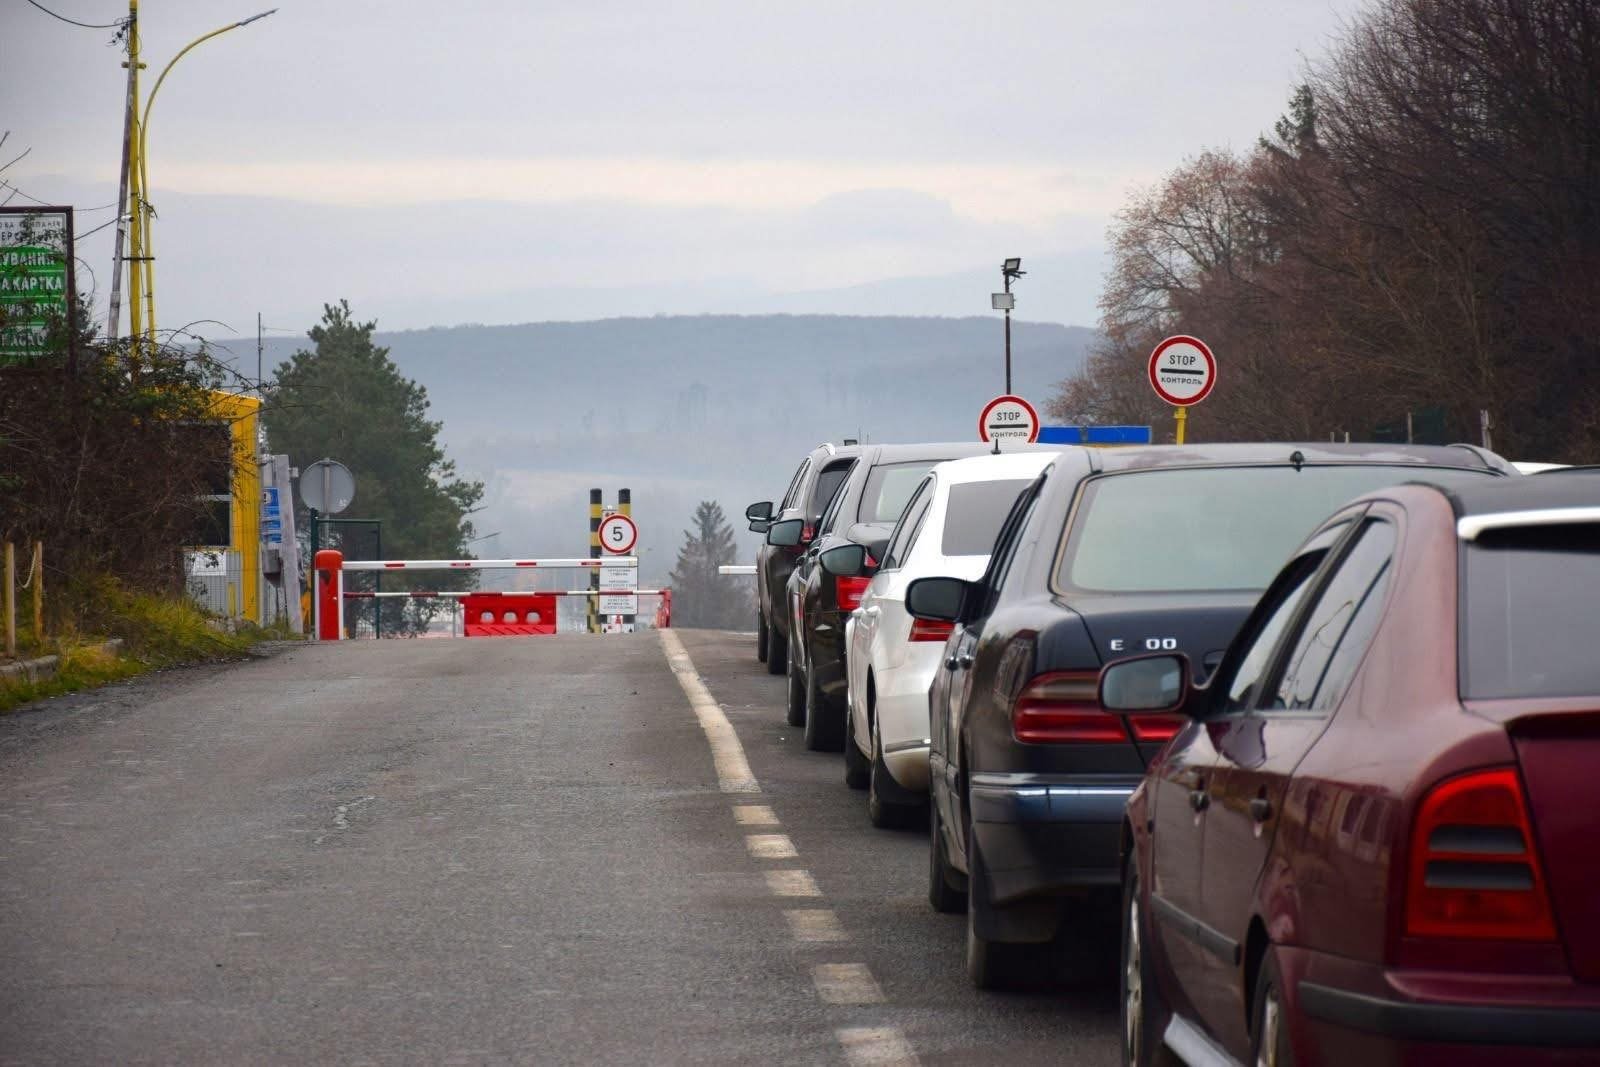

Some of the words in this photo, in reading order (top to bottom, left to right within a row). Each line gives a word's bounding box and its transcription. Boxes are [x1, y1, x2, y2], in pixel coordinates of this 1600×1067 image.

[12, 276, 62, 290] КАРТКА
[1169, 354, 1196, 366] STOP
[1161, 376, 1203, 386] КОНТРОЛЬ
[996, 411, 1021, 421] STOP
[990, 431, 1028, 439] КОНТРОЛЬ
[612, 526, 623, 542] 5
